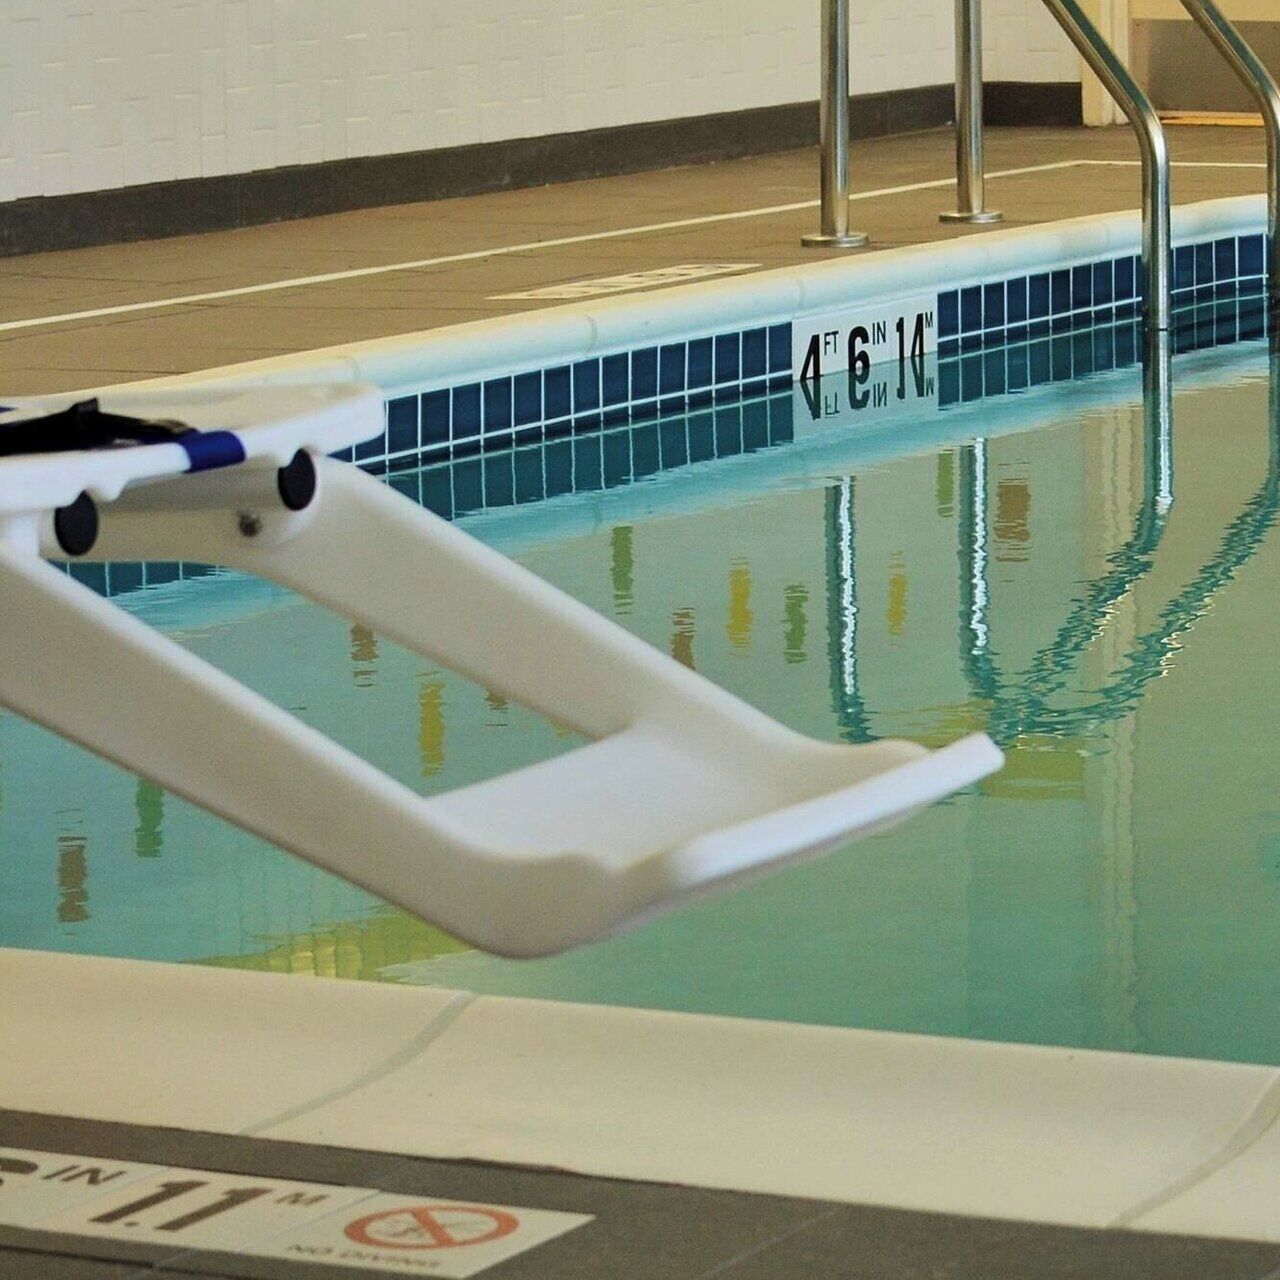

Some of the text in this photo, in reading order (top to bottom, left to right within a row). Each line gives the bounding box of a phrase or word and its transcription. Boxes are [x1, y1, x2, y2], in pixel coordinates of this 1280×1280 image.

[824, 331, 839, 355] FT
[873, 321, 886, 345] IN
[925, 311, 933, 328] M
[42, 1165, 126, 1185] IN
